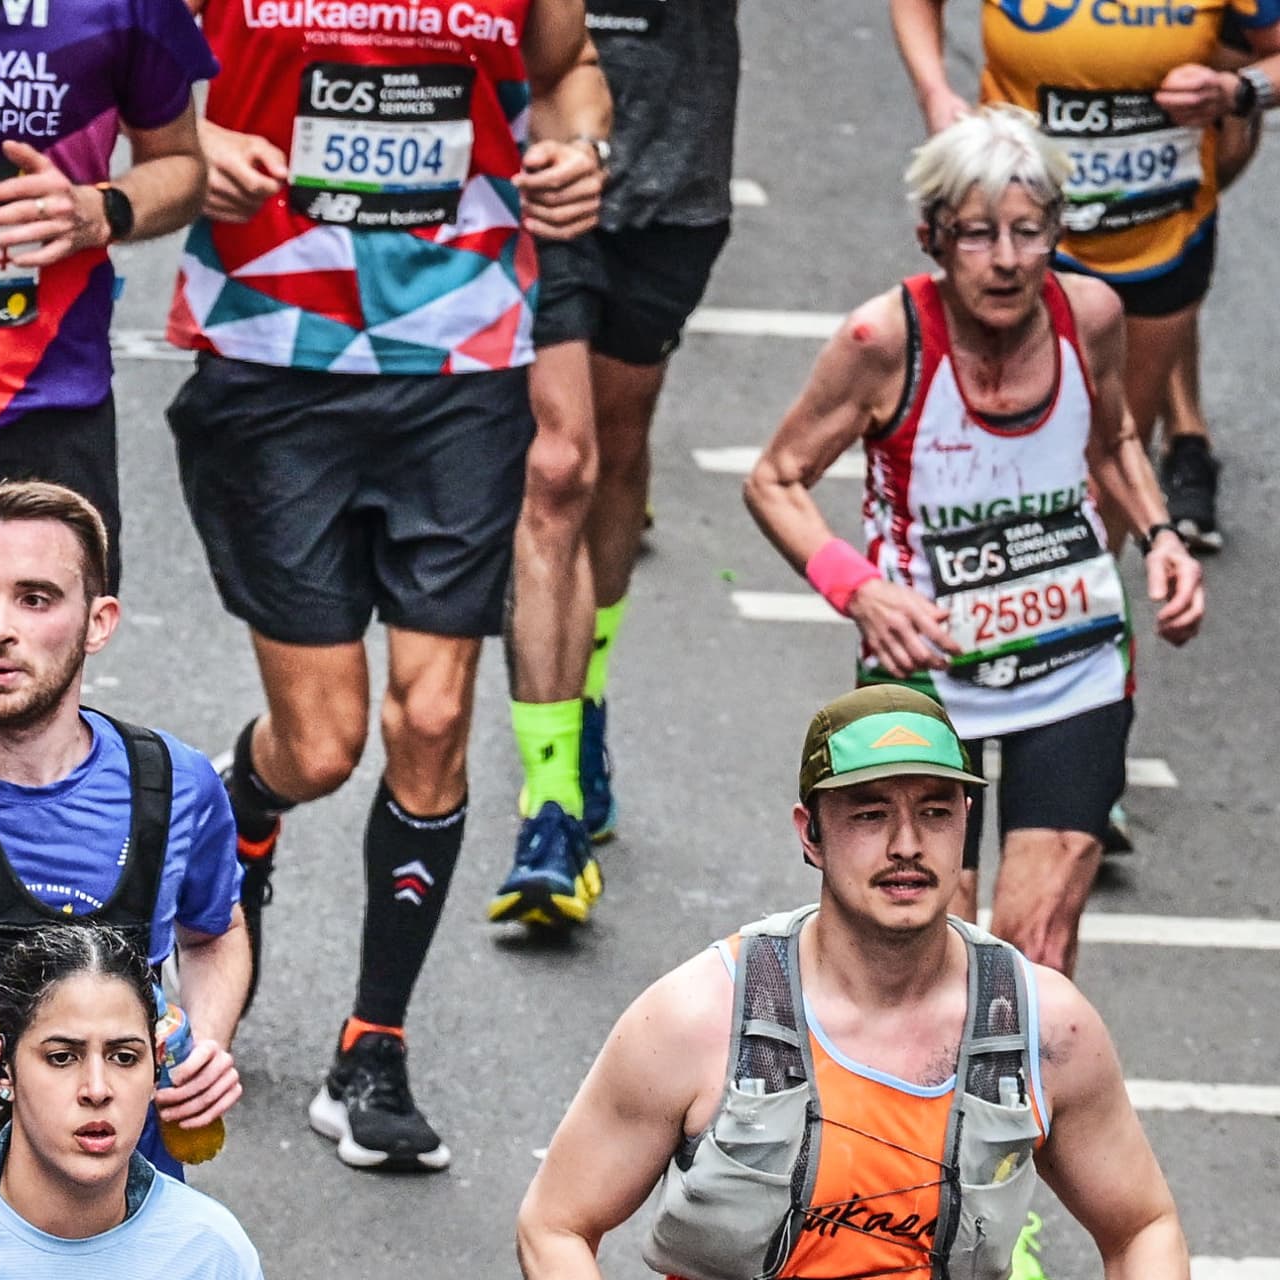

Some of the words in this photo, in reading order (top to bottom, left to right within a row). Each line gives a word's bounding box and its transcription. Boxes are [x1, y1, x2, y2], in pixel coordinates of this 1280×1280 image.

[243, 0, 441, 34] Leukaemia
[310, 69, 376, 113] tcs
[323, 134, 443, 176] 58504
[1003, 522, 1044, 541] TATA
[934, 541, 1006, 586] tcs
[1009, 545, 1069, 571] SERVICES
[971, 577, 1090, 642] 25891
